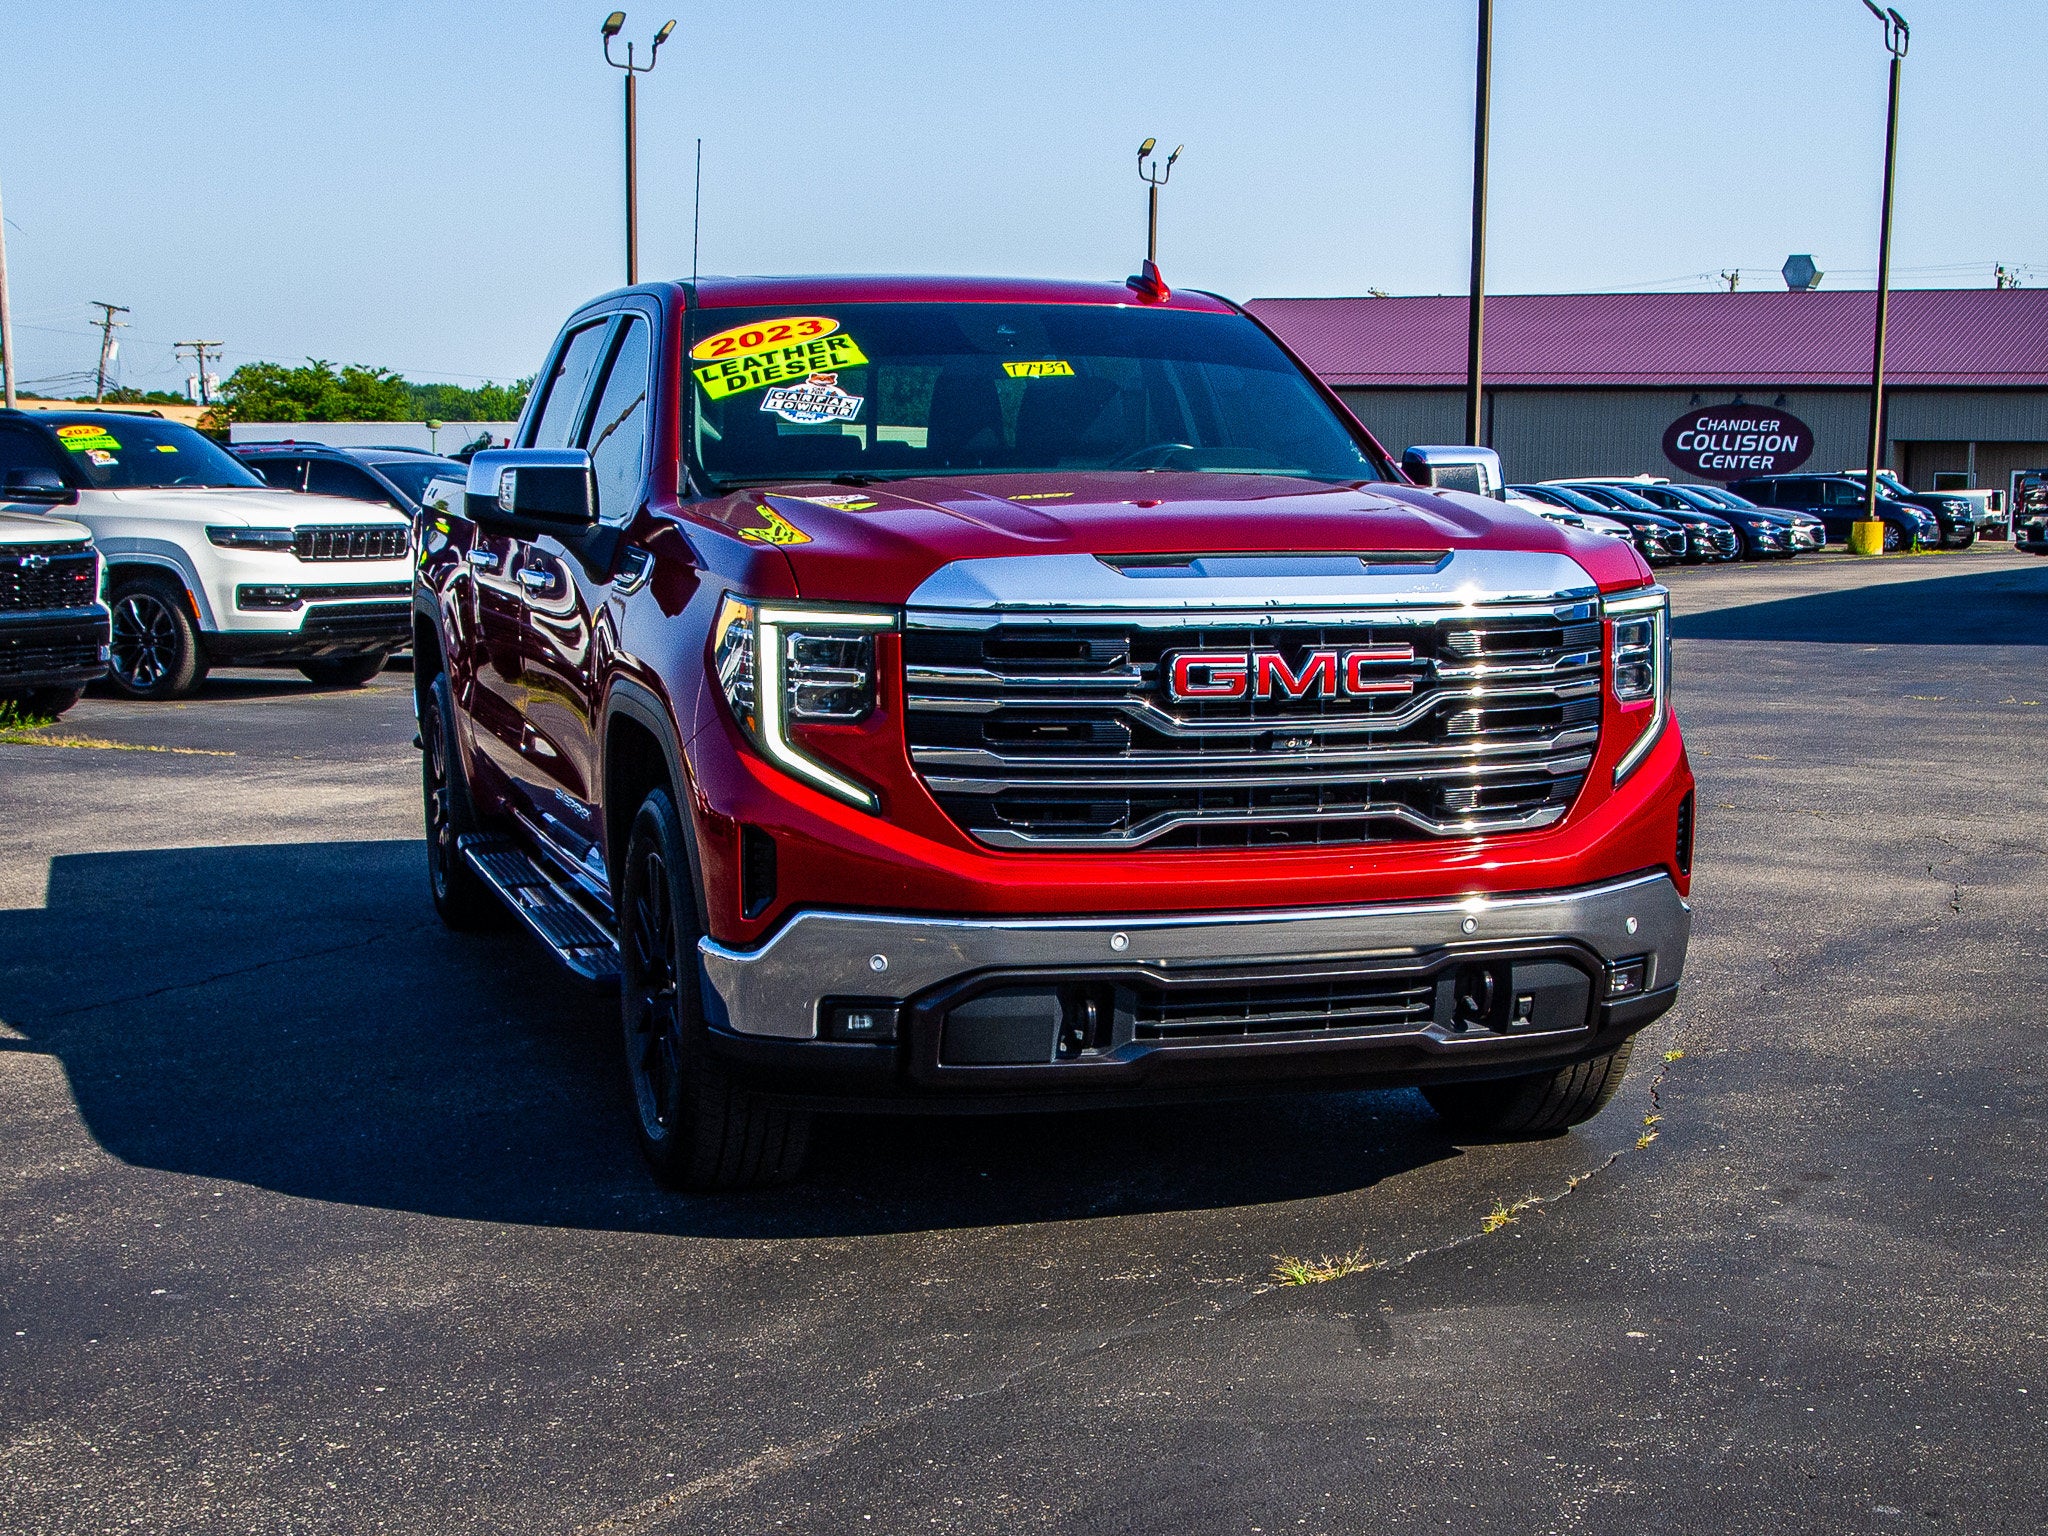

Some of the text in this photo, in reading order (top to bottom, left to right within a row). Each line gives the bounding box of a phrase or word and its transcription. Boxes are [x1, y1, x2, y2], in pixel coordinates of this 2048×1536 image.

[711, 321, 822, 357] 2023
[702, 337, 850, 382] LEATHER
[726, 353, 848, 391] DIESEL
[772, 391, 852, 408] CARFAX
[783, 402, 852, 417] OWNER
[1696, 417, 1780, 431] CHANDLER
[1677, 431, 1799, 452] COLLISION
[1699, 452, 1775, 470] CENTER
[1169, 646, 1415, 703] GMC
